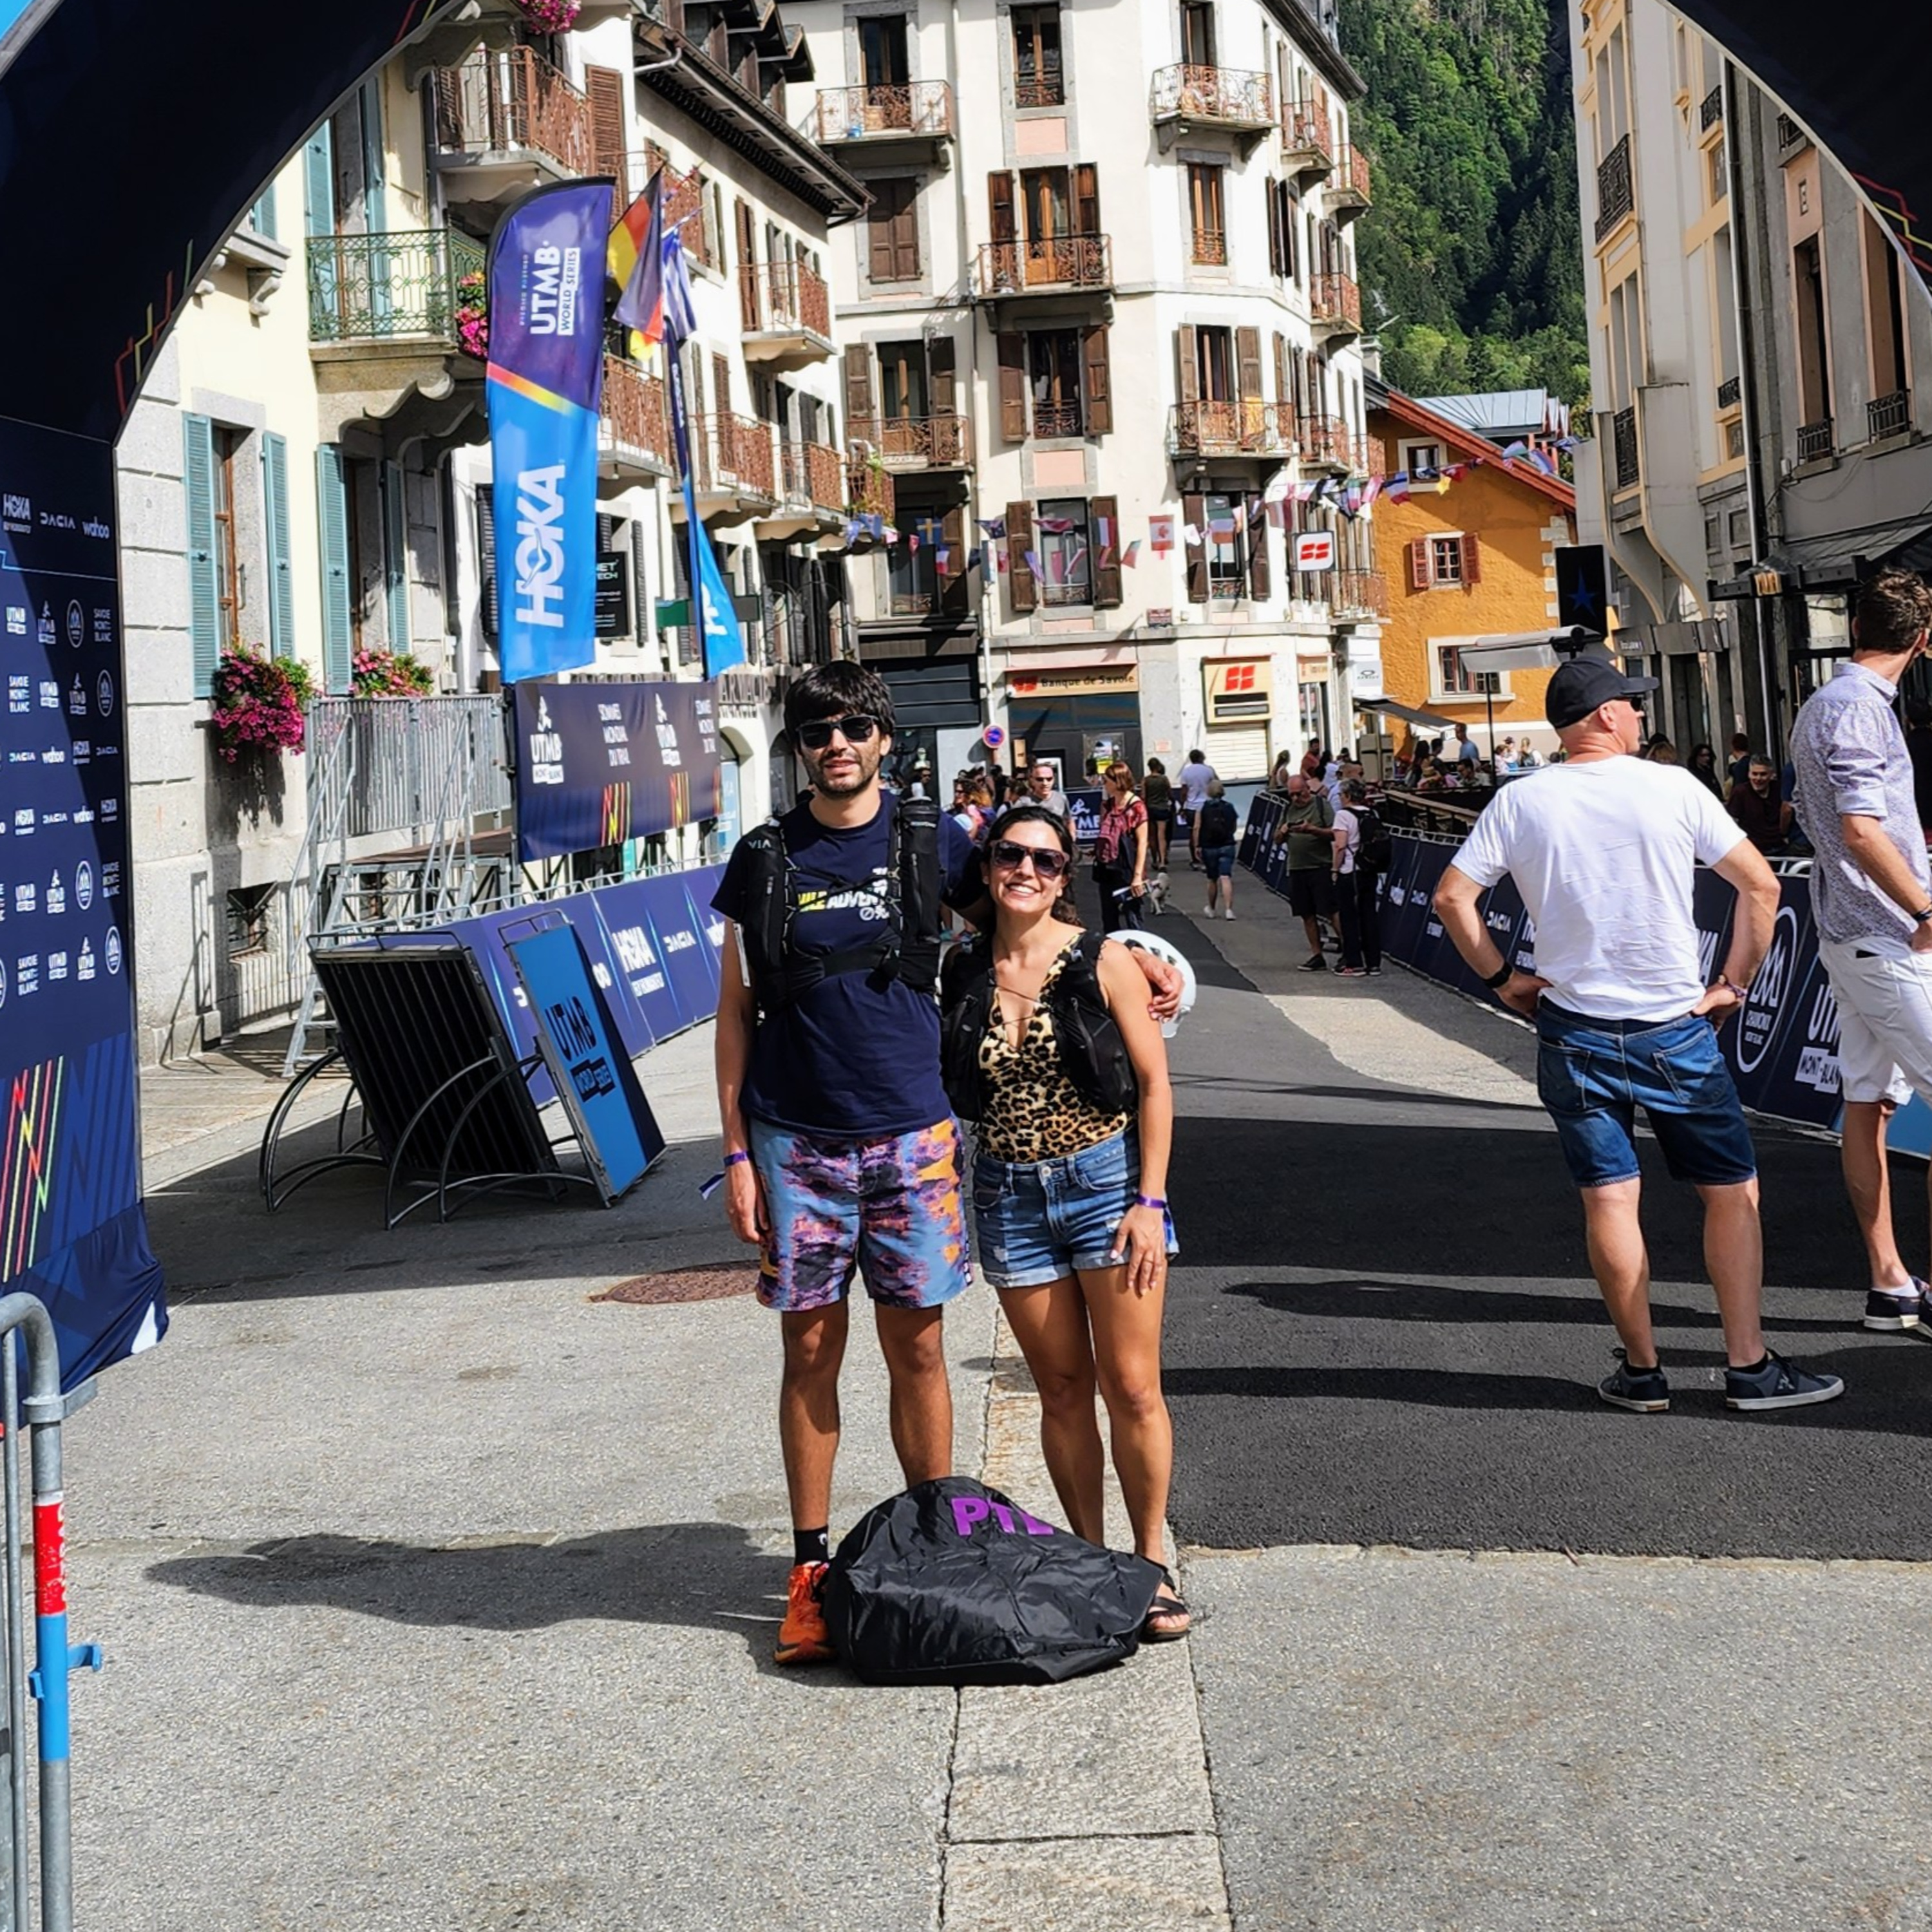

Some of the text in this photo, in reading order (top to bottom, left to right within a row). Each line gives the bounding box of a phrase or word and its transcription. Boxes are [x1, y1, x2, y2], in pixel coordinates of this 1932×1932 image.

[530, 245, 560, 334] UTMB
[561, 251, 577, 331] WORLD SERIES
[3, 493, 31, 520] HOKA
[40, 512, 76, 529] DACIA
[515, 464, 565, 628] HOKA
[1041, 674, 1134, 688] Banque de Savoie
[530, 732, 562, 764] UTMB
[612, 926, 656, 974] HOKA
[545, 996, 598, 1062] UTMB
